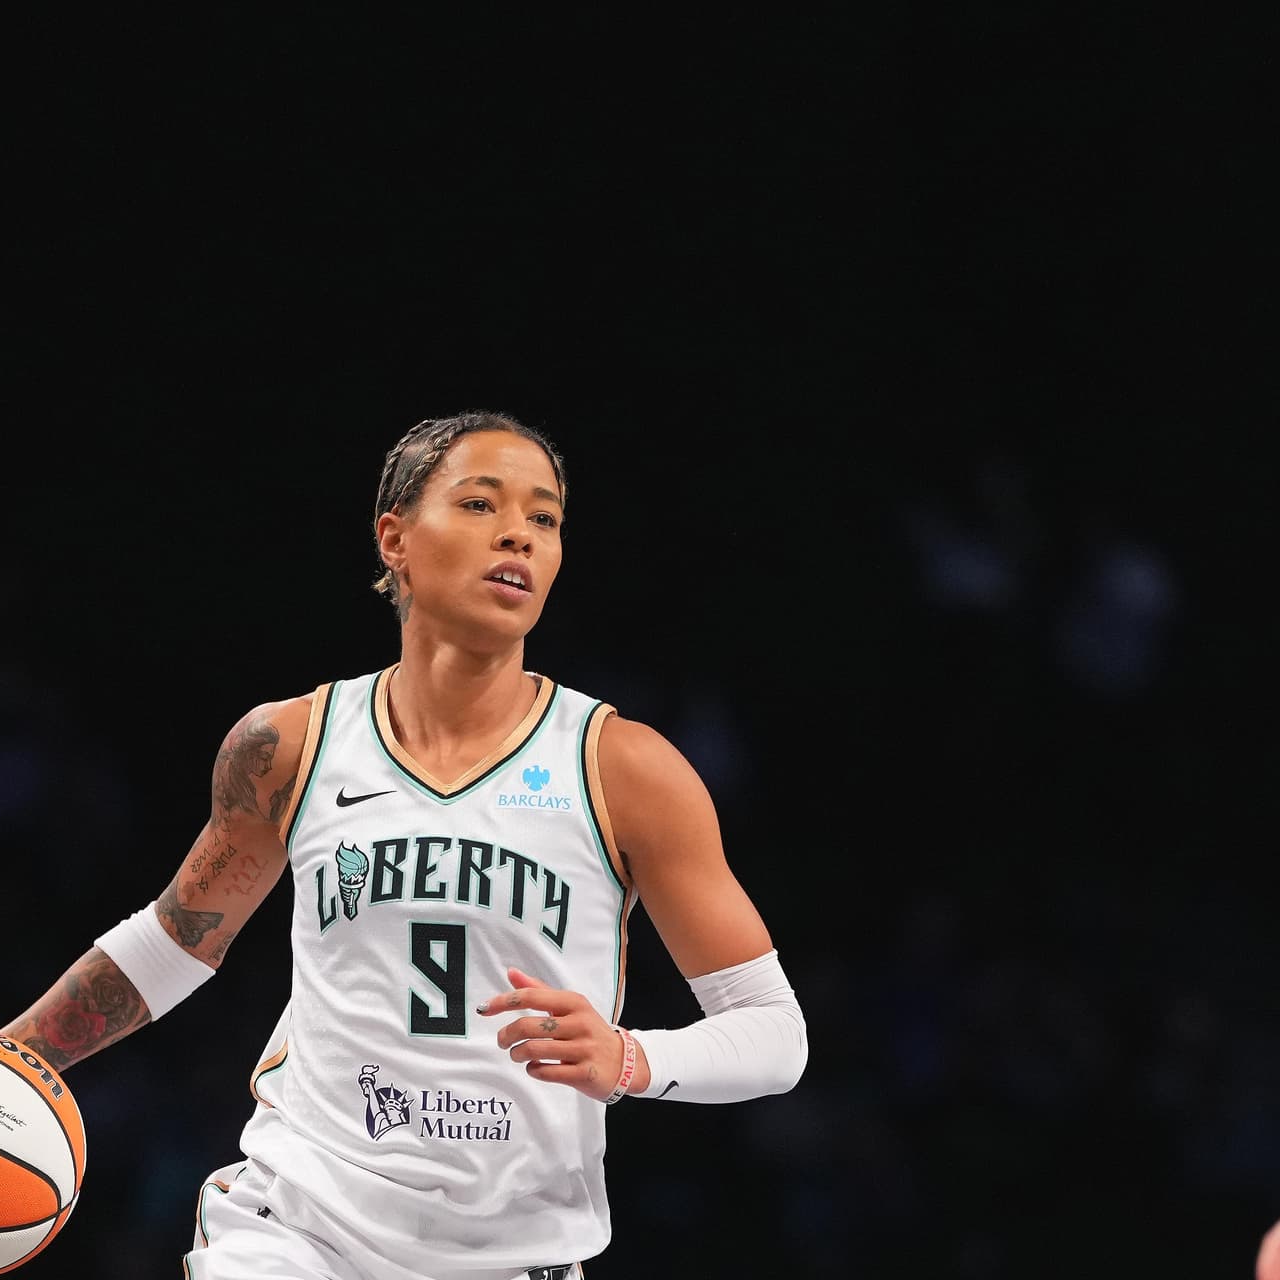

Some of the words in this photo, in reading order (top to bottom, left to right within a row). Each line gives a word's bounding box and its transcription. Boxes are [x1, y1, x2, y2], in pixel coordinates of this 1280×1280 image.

[498, 794, 572, 810] BARCLAYS
[408, 920, 470, 1040] 9
[420, 1090, 513, 1125] Liberty
[420, 1116, 512, 1141] Mutual
